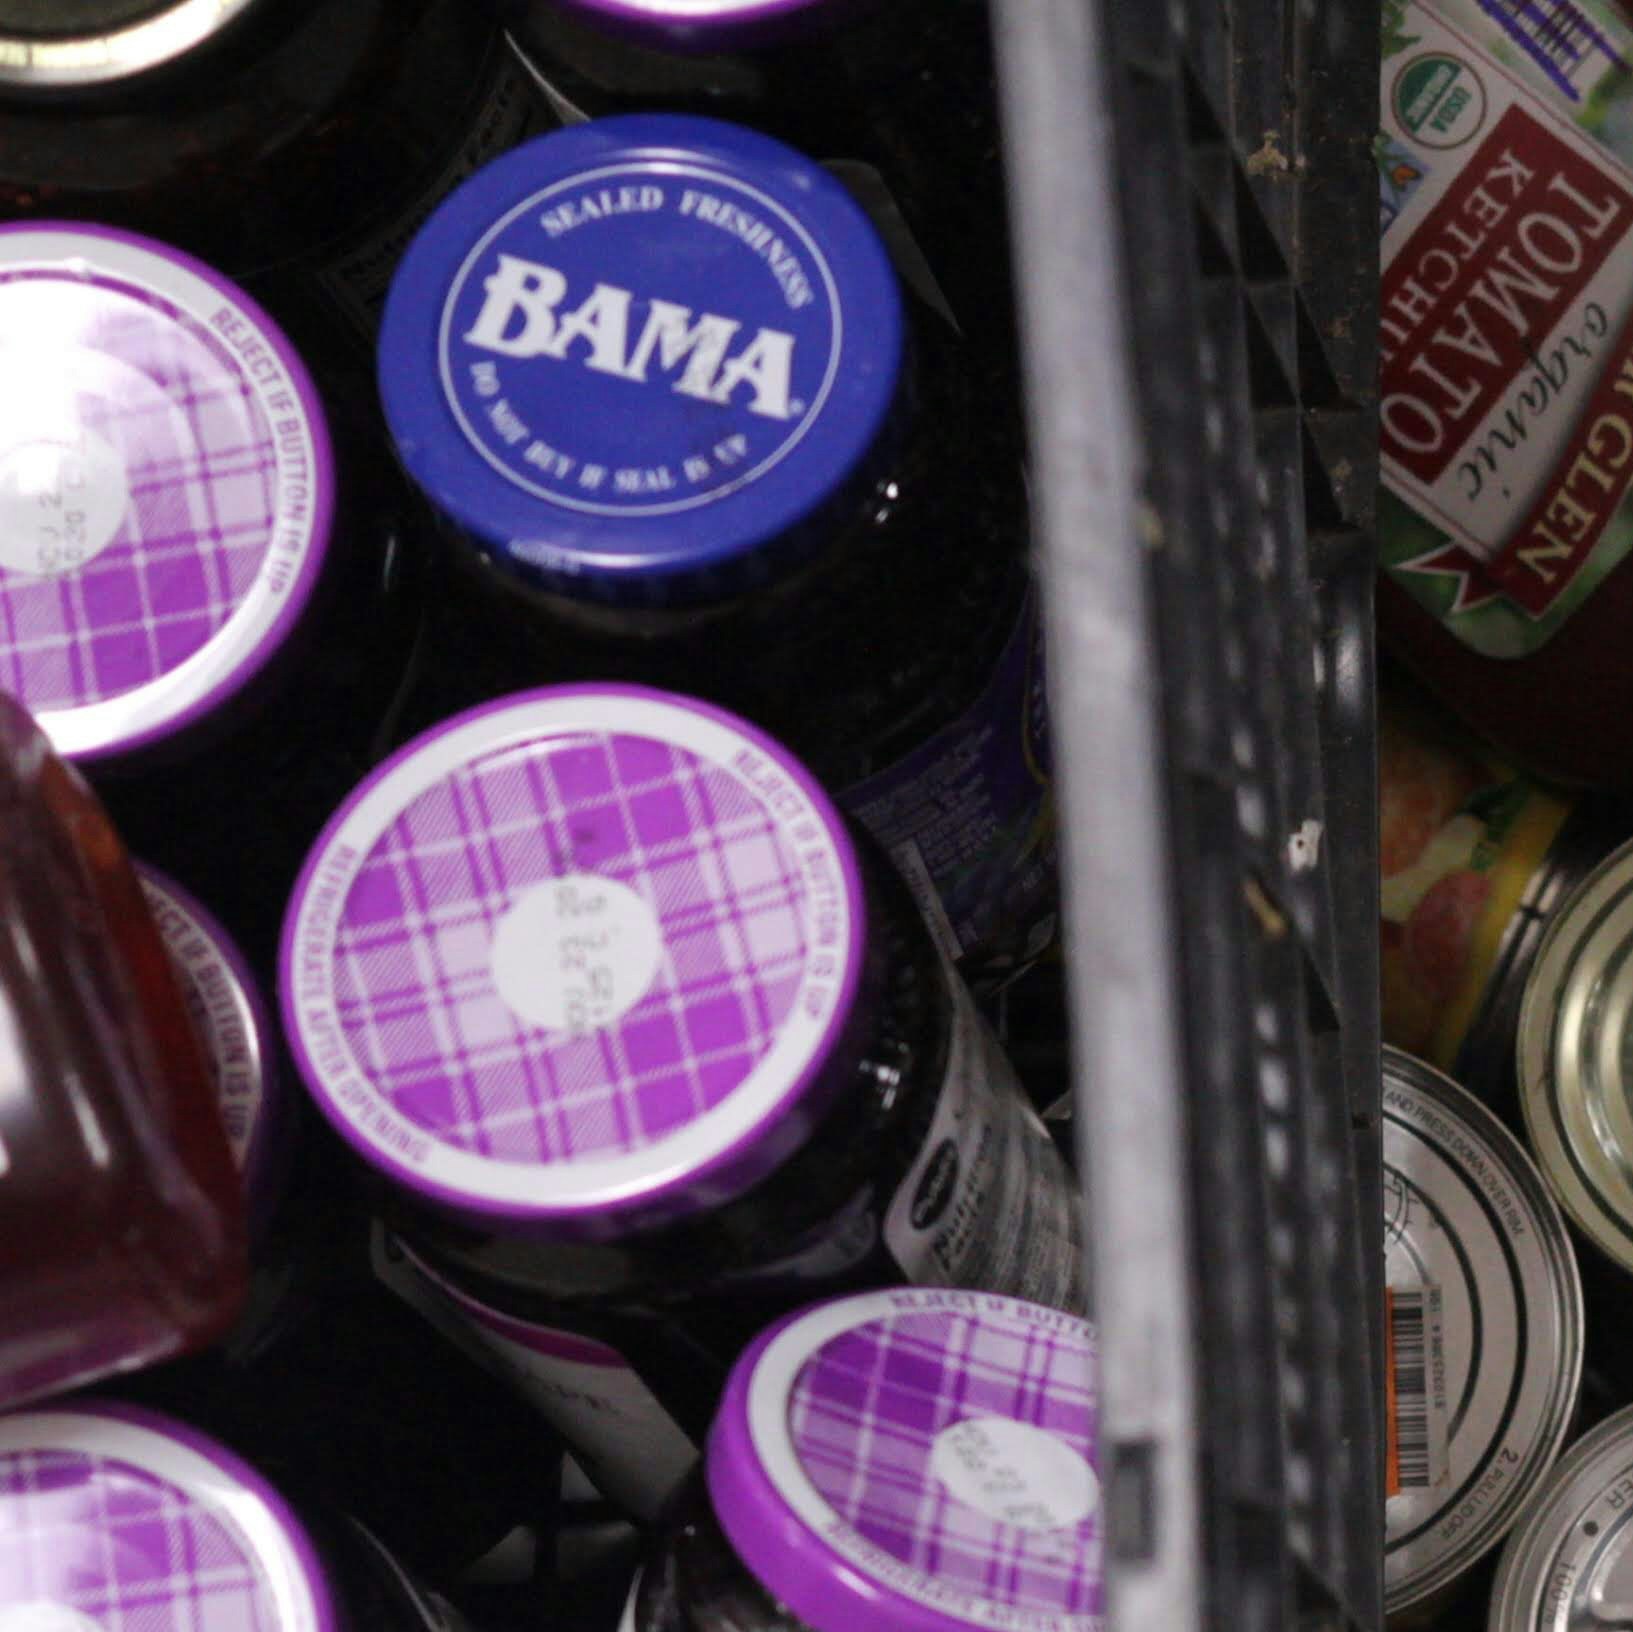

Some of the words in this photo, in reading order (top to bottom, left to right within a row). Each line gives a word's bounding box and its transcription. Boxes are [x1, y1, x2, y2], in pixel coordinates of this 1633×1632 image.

[540, 186, 664, 238] SEALED
[680, 189, 814, 309] FRESHNESS
[209, 307, 284, 387] REJECT
[463, 253, 796, 421] BAMA
[1380, 172, 1623, 456] TOMATO
[274, 390, 299, 413] IF
[470, 361, 500, 397] DO
[490, 399, 530, 444] NOT
[614, 466, 677, 494] SEAL
[1457, 303, 1609, 502] organic
[275, 418, 309, 513] BUTTON
[733, 749, 802, 823] REJECT
[800, 846, 839, 947] BUTTON
[300, 843, 358, 1003] REFRIGERATE
[300, 1007, 340, 1076] AFTER
[326, 1076, 431, 1165] OPENING
[1413, 1103, 1456, 1148] PRESS
[1450, 1131, 1488, 1177] DOWN
[1016, 1304, 1098, 1340] BUTTO
[1493, 1443, 1520, 1471] 2.
